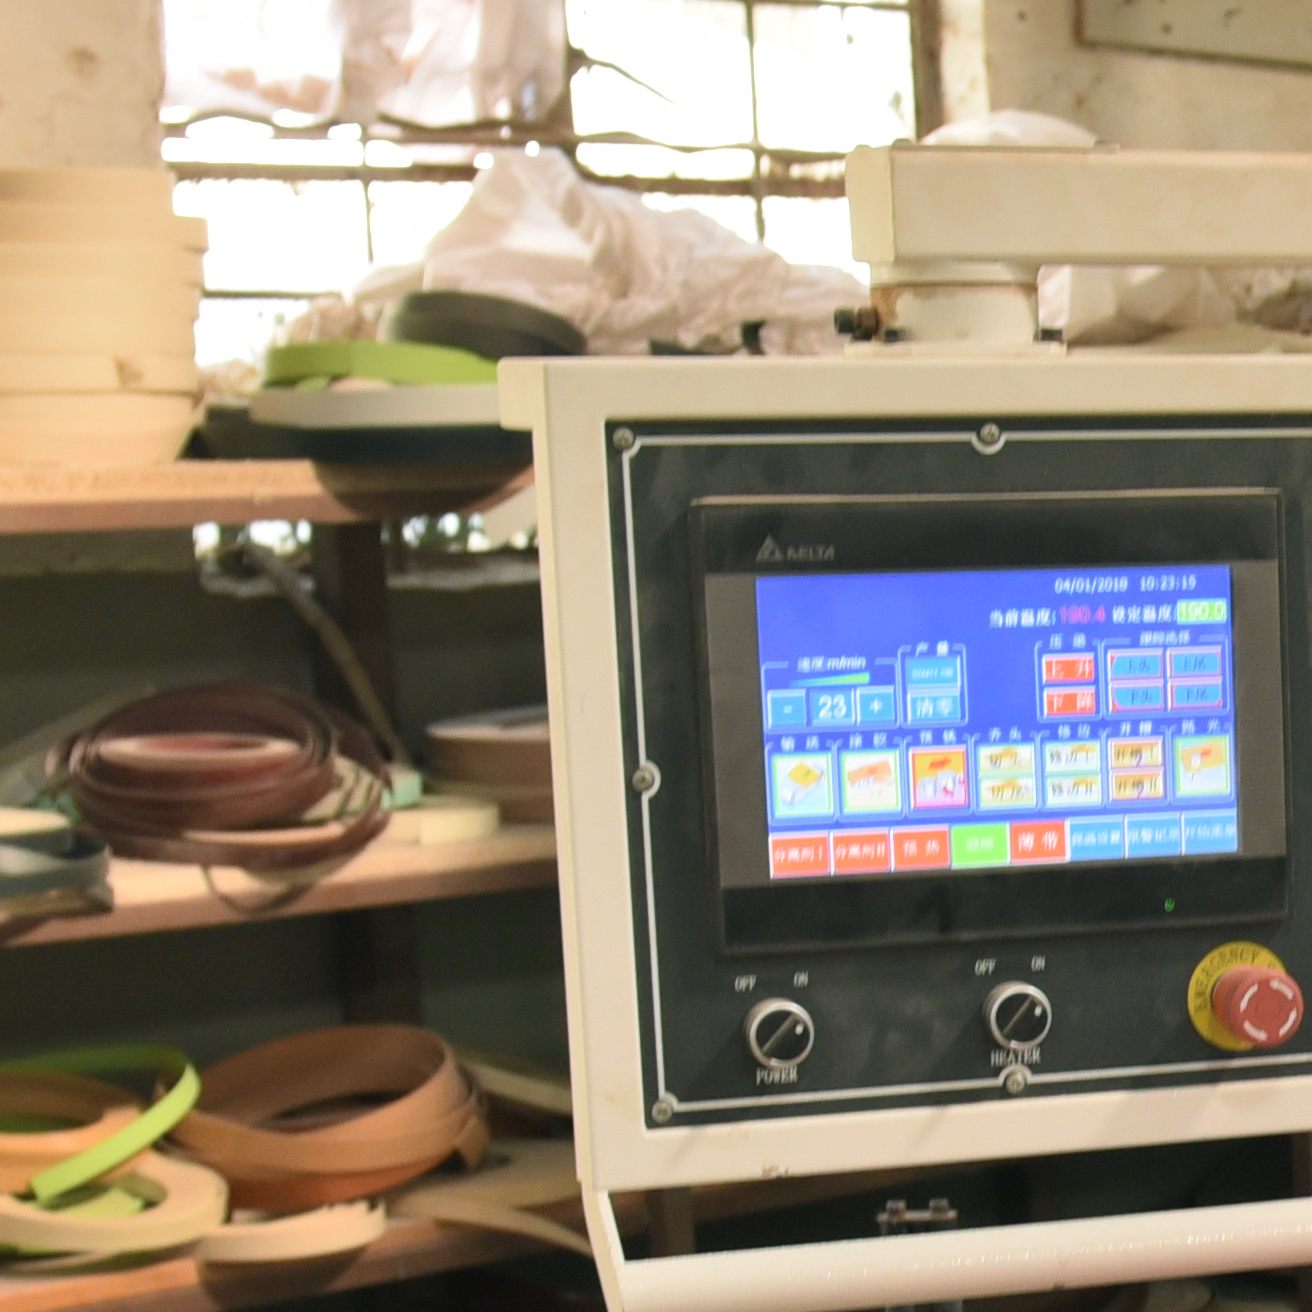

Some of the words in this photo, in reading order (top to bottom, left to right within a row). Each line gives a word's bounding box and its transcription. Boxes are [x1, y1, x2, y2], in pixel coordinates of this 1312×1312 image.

[787, 545, 835, 561] DELTA
[818, 694, 848, 719] 23
[975, 958, 996, 976] OFF
[1031, 954, 1046, 972] ON
[735, 974, 757, 992] OFF
[793, 971, 809, 988] ON
[990, 1047, 1041, 1067] HEATER
[756, 1064, 798, 1085] POWER
